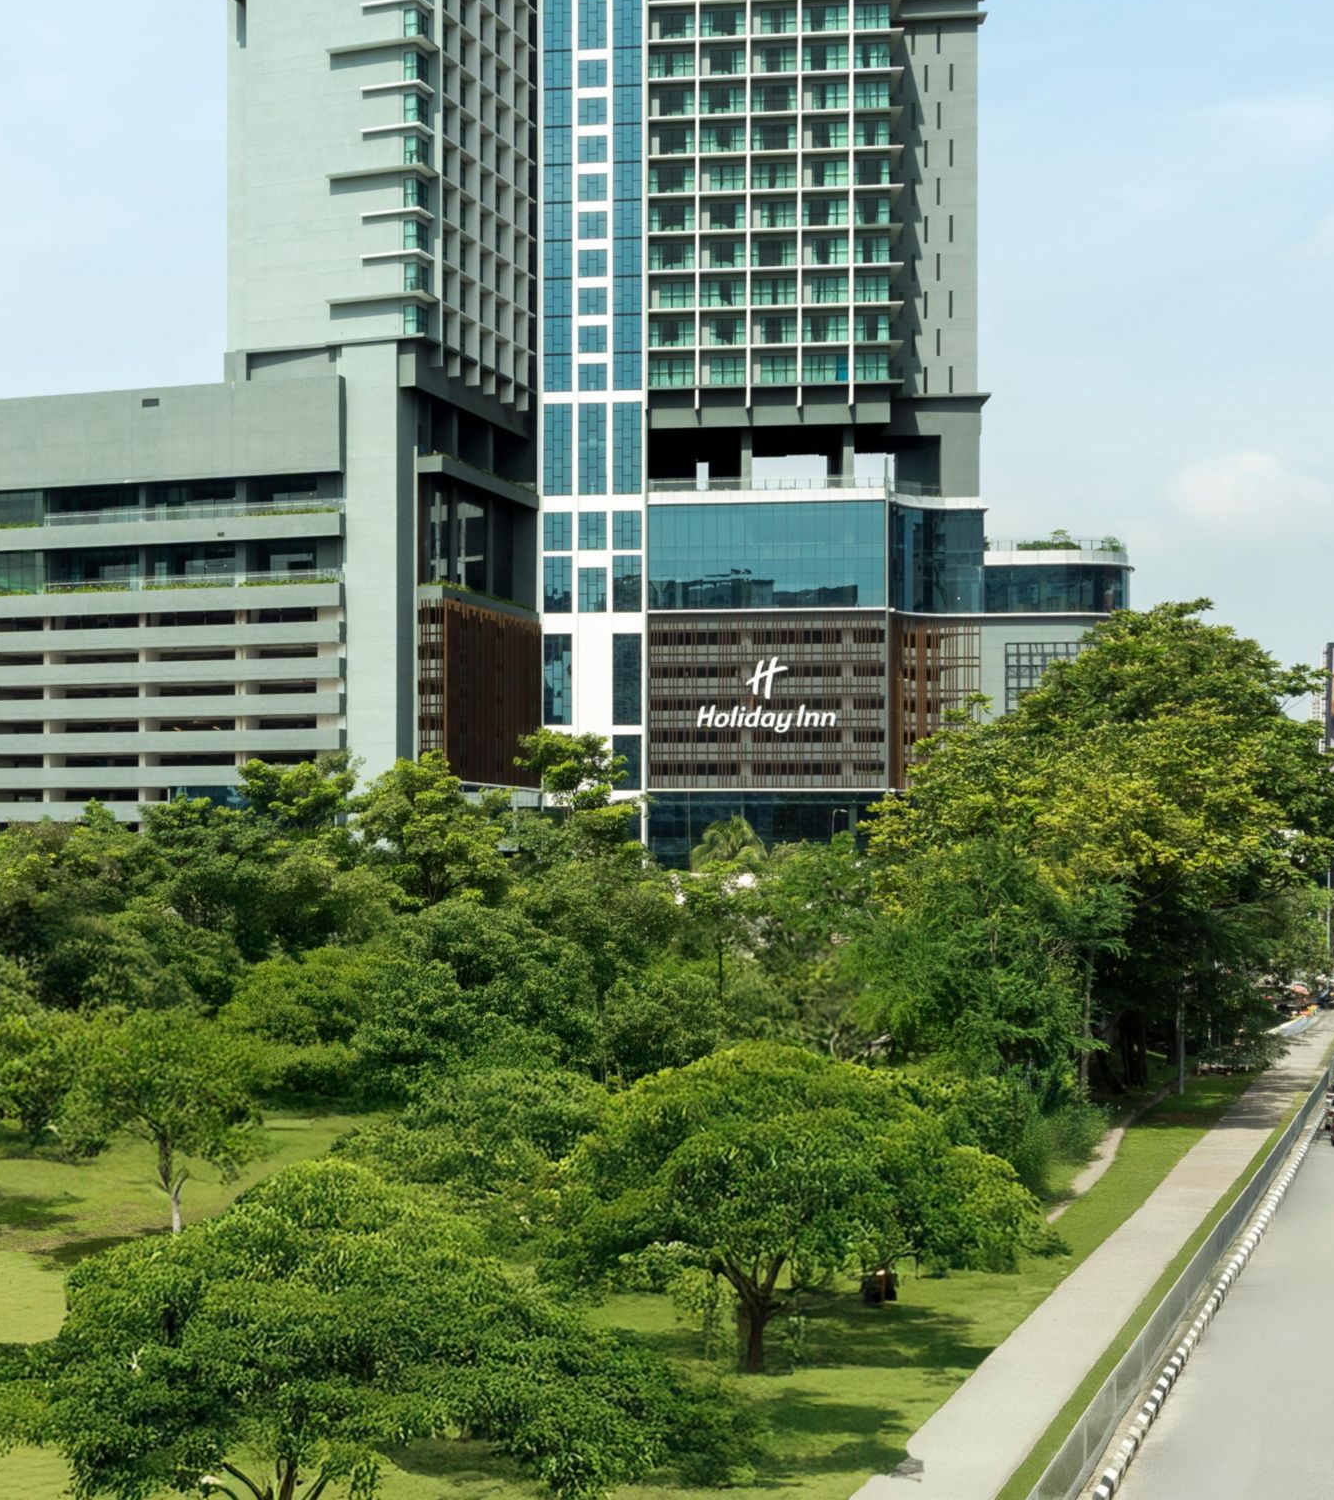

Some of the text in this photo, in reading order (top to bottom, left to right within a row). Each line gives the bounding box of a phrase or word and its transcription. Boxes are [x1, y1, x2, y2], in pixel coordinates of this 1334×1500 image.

[745, 656, 789, 700] H
[696, 704, 837, 733] Holiday Inn
